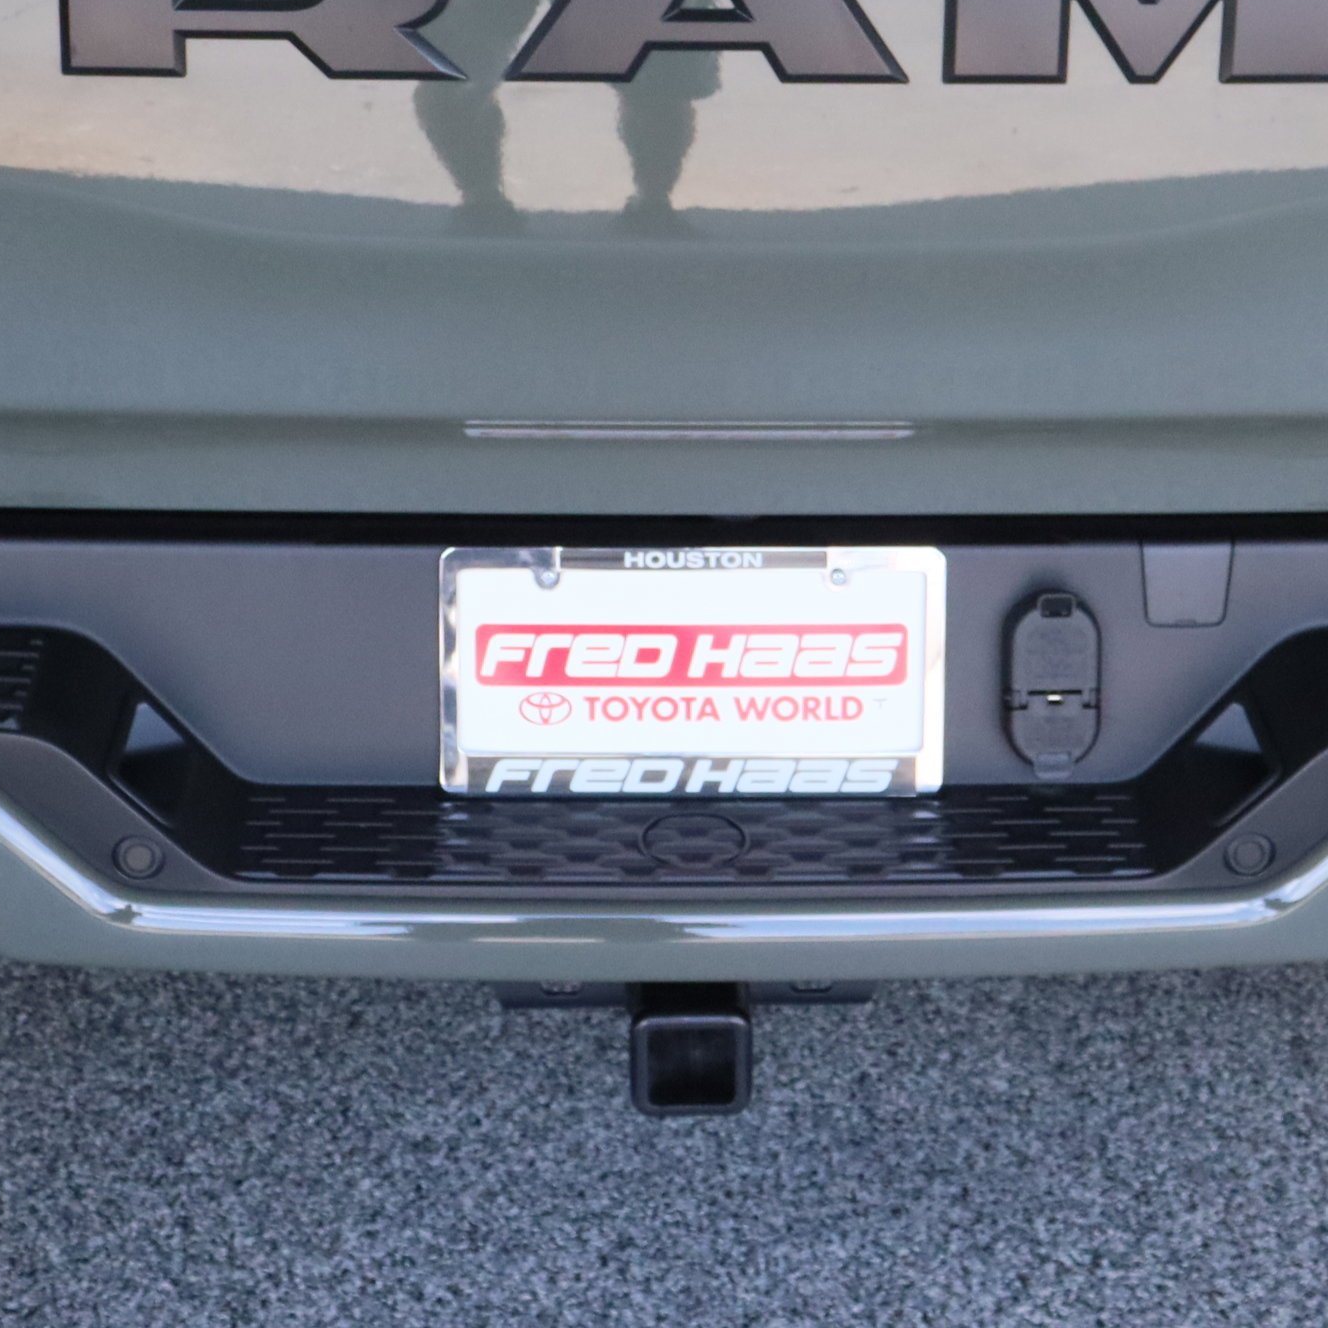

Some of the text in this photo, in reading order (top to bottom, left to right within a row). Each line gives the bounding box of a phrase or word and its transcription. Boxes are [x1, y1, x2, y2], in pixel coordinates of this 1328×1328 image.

[623, 551, 763, 569] HOUSTON
[584, 695, 864, 722] TOYOTA WORLD
